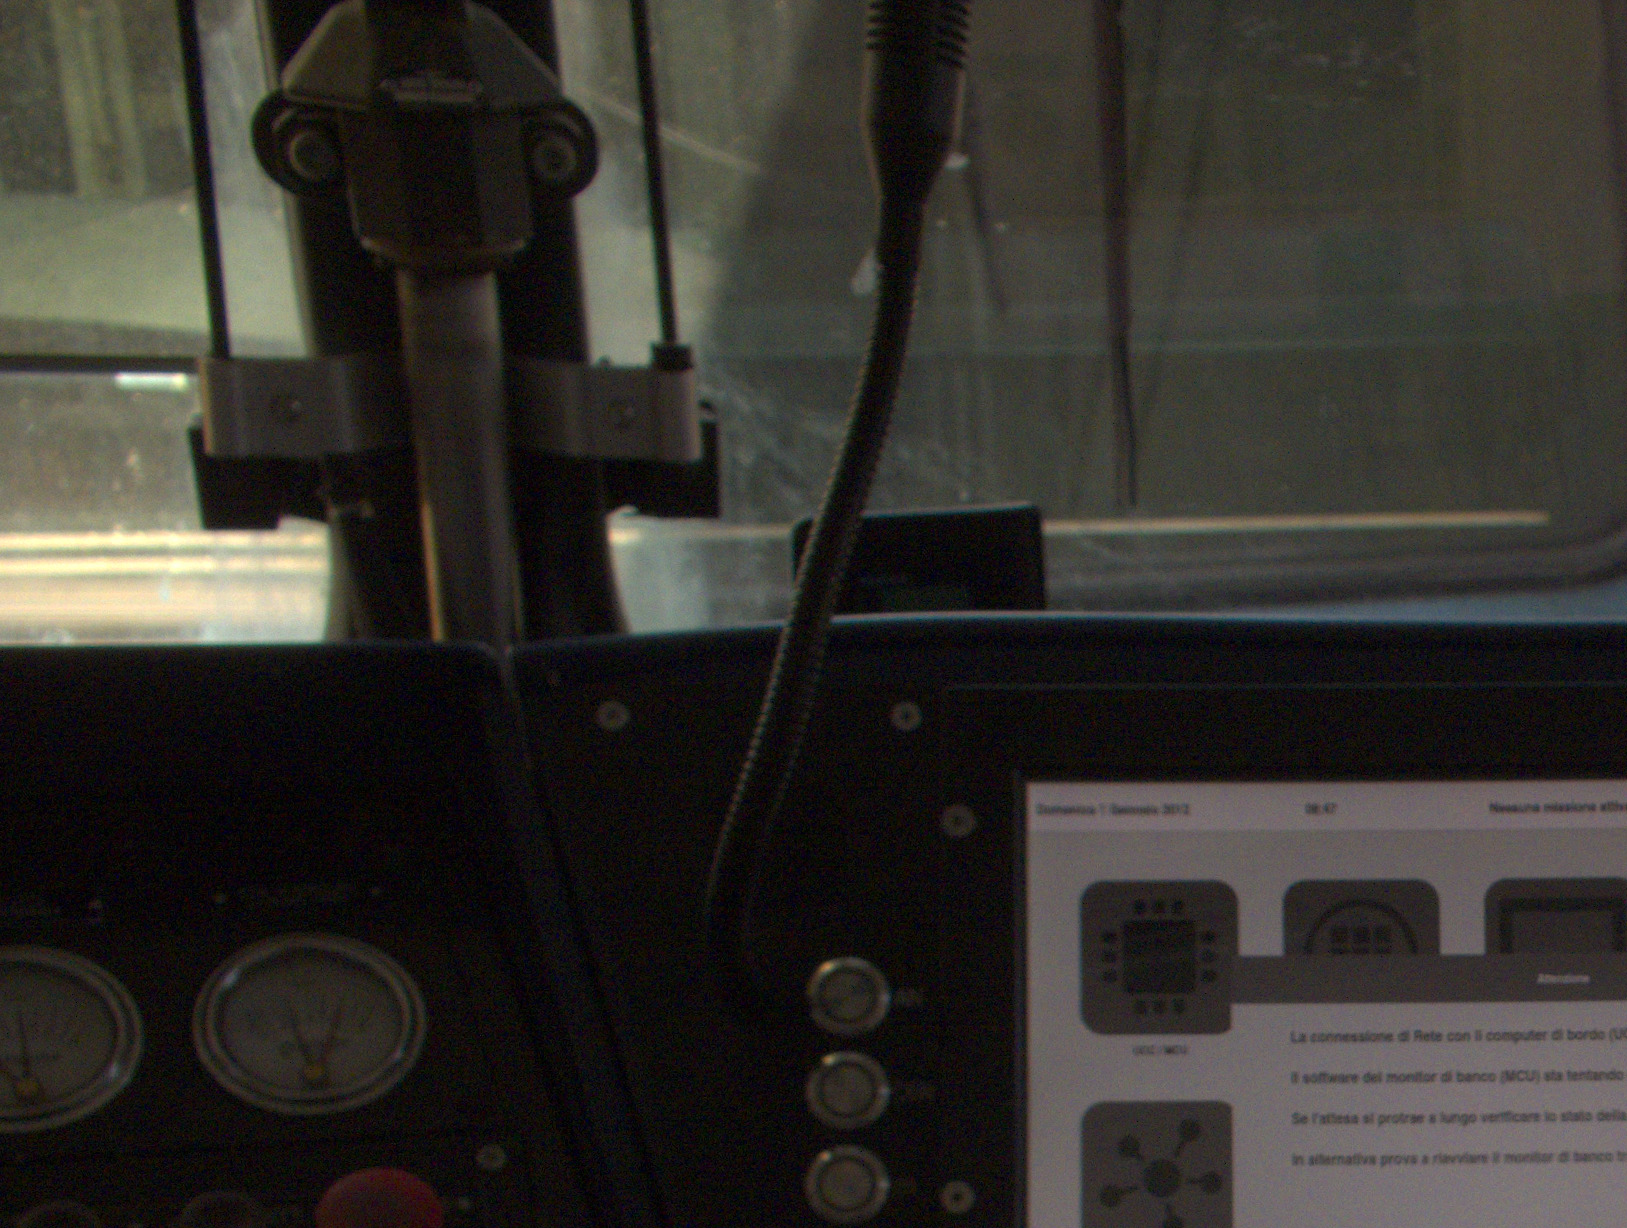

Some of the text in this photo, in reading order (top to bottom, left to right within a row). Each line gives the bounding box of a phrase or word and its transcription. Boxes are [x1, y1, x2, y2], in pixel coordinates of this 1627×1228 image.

[1489, 803, 1540, 813] Nessuna
[1543, 803, 1597, 813] missione
[1290, 1032, 1306, 1044] La
[1310, 1032, 1394, 1043] connessione
[1414, 1030, 1443, 1042] Rete
[1447, 1032, 1470, 1042] con
[1486, 1030, 1547, 1044] computer
[1567, 1029, 1605, 1041] bordo
[1302, 1072, 1359, 1084] software
[1363, 1072, 1382, 1084] del
[1386, 1071, 1437, 1083] monitor
[1456, 1071, 1496, 1083] banco
[1500, 1070, 1540, 1083] (MCU)
[1544, 1070, 1563, 1082] sta
[1567, 1070, 1624, 1081] tentando
[1291, 1112, 1308, 1125] Se
[1378, 1113, 1425, 1126] protrae
[1440, 1112, 1477, 1126] lungo
[1481, 1111, 1541, 1123] verificare
[1560, 1111, 1593, 1122] stato
[1596, 1110, 1627, 1122] della
[1308, 1154, 1377, 1166] alternativa
[1380, 1155, 1418, 1167] prova
[1433, 1153, 1488, 1164] riavviare
[1504, 1152, 1554, 1164] monitor
[1573, 1152, 1614, 1163] banco
